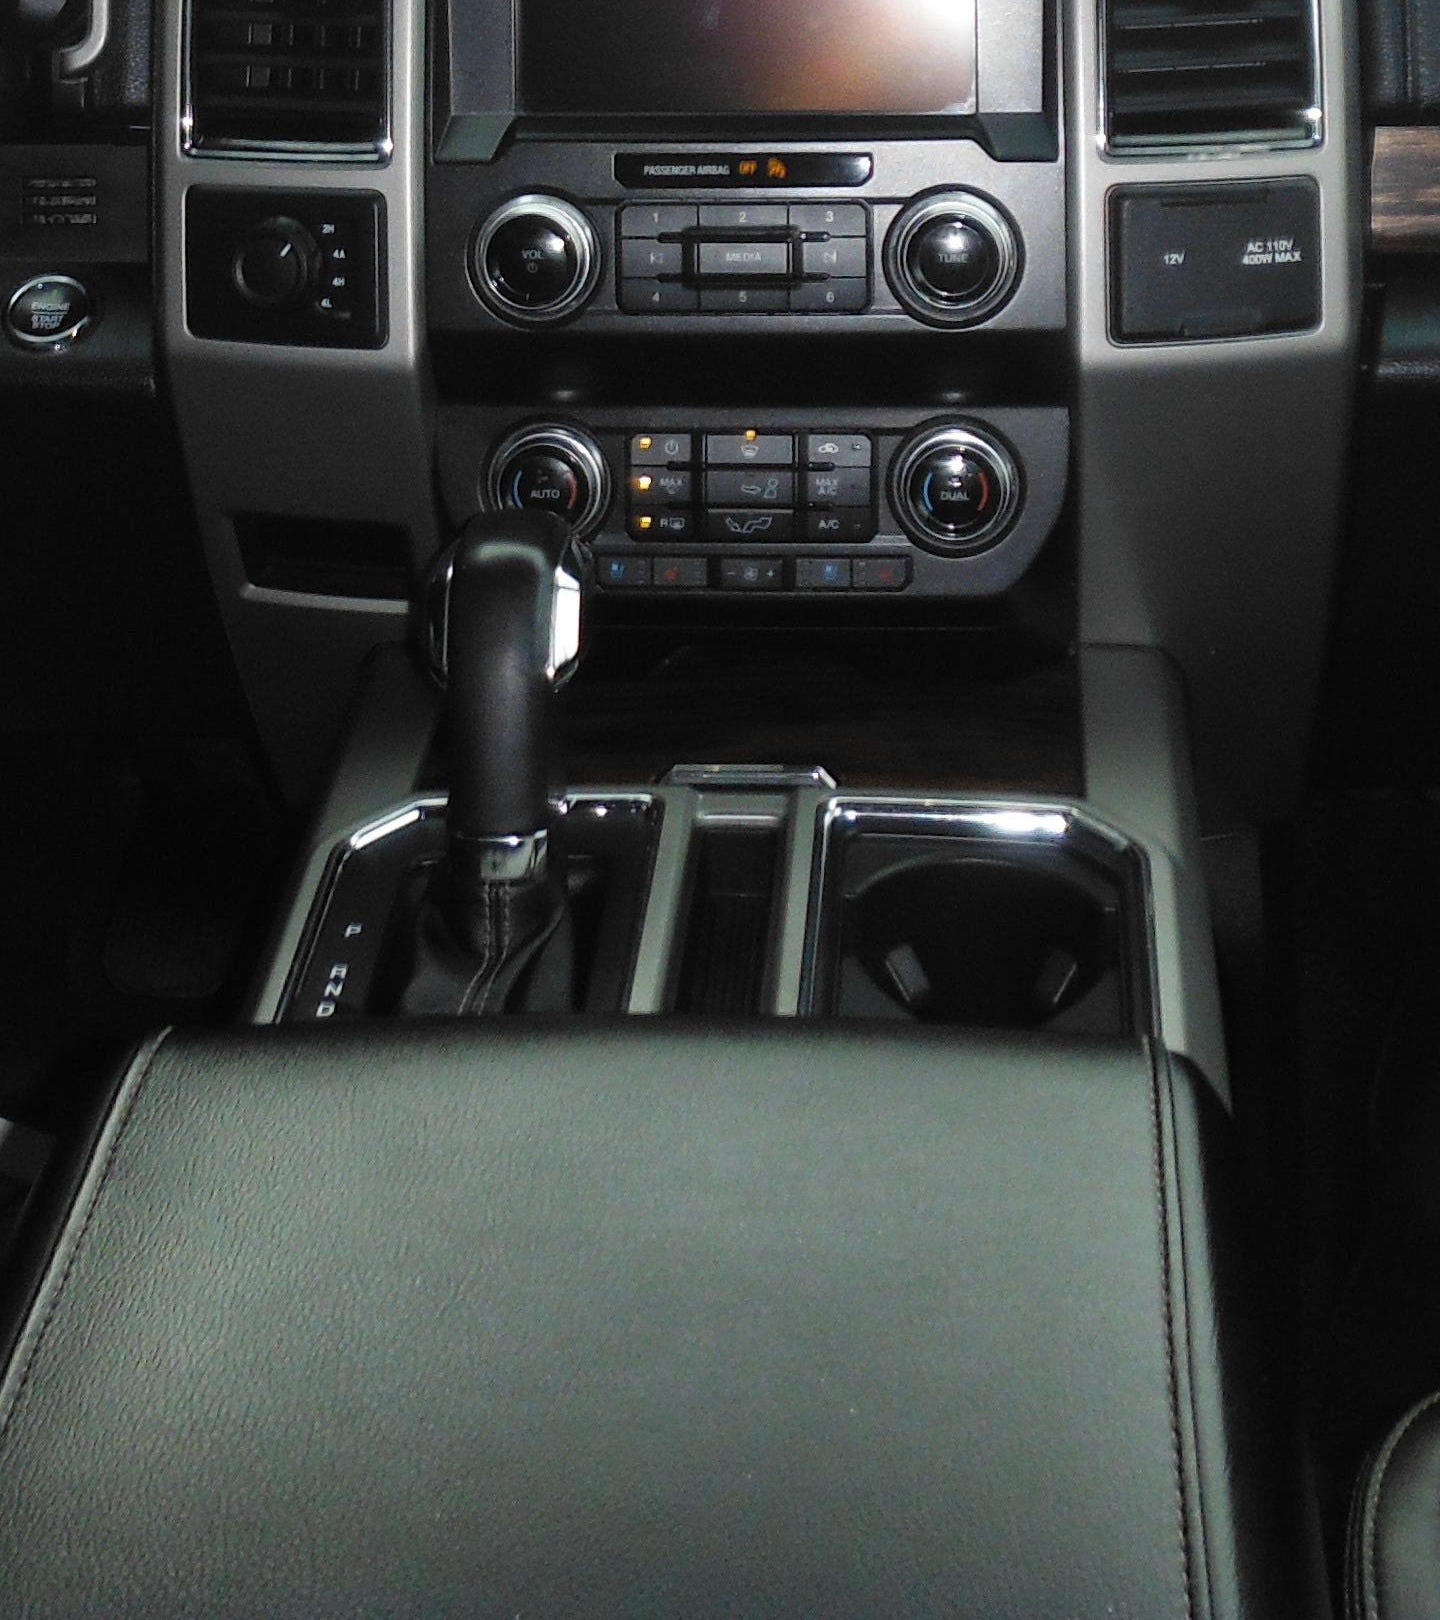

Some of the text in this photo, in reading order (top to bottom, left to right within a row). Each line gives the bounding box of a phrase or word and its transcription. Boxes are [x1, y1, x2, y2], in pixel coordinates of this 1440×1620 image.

[643, 160, 758, 176] PASSENGER AIRBAG OFF
[739, 211, 748, 223] 2
[825, 211, 835, 223] 3
[321, 223, 335, 235] 2H
[1246, 238, 1294, 254] AC 110V
[332, 248, 346, 260] 4A
[521, 249, 544, 260] VOL
[725, 252, 762, 262] MEDIA
[937, 252, 969, 264] TUNE
[1163, 251, 1185, 265] 12V
[1242, 250, 1302, 266] 400W MAX
[331, 276, 346, 288] 4H
[320, 297, 333, 309] 4L
[651, 291, 835, 303] 4 5 6
[530, 489, 561, 499] AUTO
[939, 490, 970, 501] DUAL
[817, 519, 840, 530] A/C
[344, 923, 363, 938] P
[323, 980, 344, 997] N
[315, 1000, 336, 1018] D
